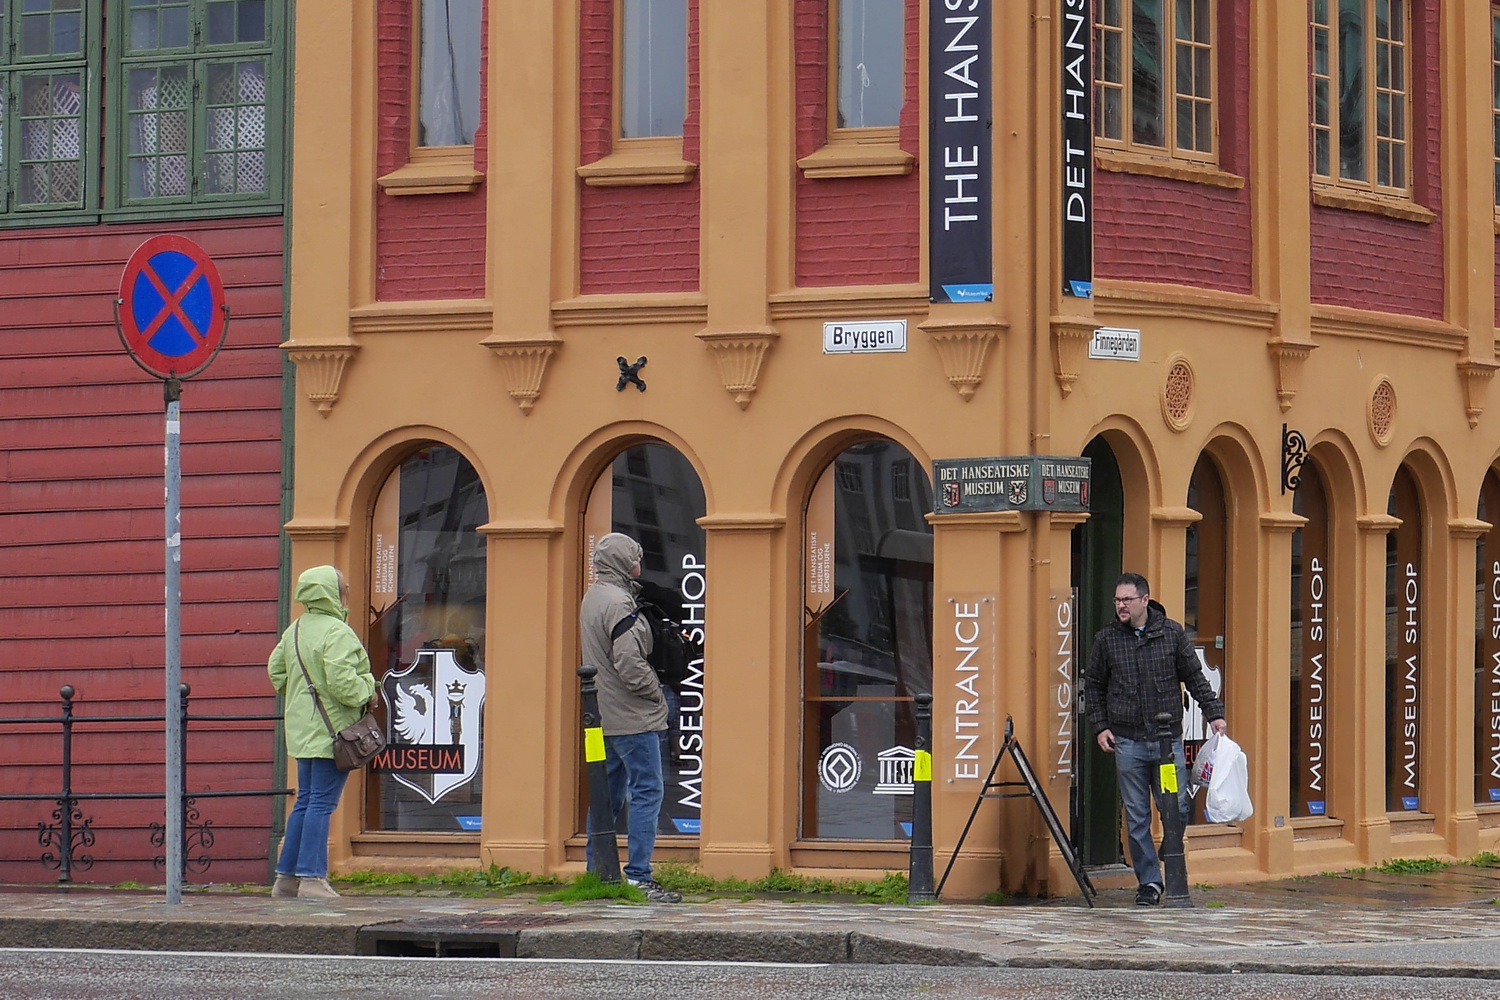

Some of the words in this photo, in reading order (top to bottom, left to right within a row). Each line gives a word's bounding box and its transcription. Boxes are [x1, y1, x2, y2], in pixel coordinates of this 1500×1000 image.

[944, 145, 979, 231] THE
[1066, 139, 1086, 223] DET
[833, 326, 894, 349] Bryggen
[940, 467, 958, 481] DET
[961, 464, 1030, 480] HANSEATISKE
[964, 480, 1005, 496] MUSEUM
[1041, 464, 1056, 477] DET
[1056, 464, 1089, 479] HANSEATISKE
[1058, 480, 1080, 494] MUSEUM
[382, 549, 388, 561] OG
[387, 545, 395, 593] SCHØTSTUENE
[817, 548, 823, 560] OG
[681, 553, 706, 646] SHOP
[1310, 557, 1324, 642] SHOP
[1405, 562, 1418, 644] SHOP
[955, 603, 980, 779] ENTRANCE
[1057, 602, 1072, 774] INNGANG
[677, 658, 705, 808] MUSEUM
[1309, 653, 1323, 791] MUSEUM
[1403, 655, 1417, 788] MUSEUM
[373, 748, 462, 770] MUSEUM
[879, 760, 913, 784] UNESC
